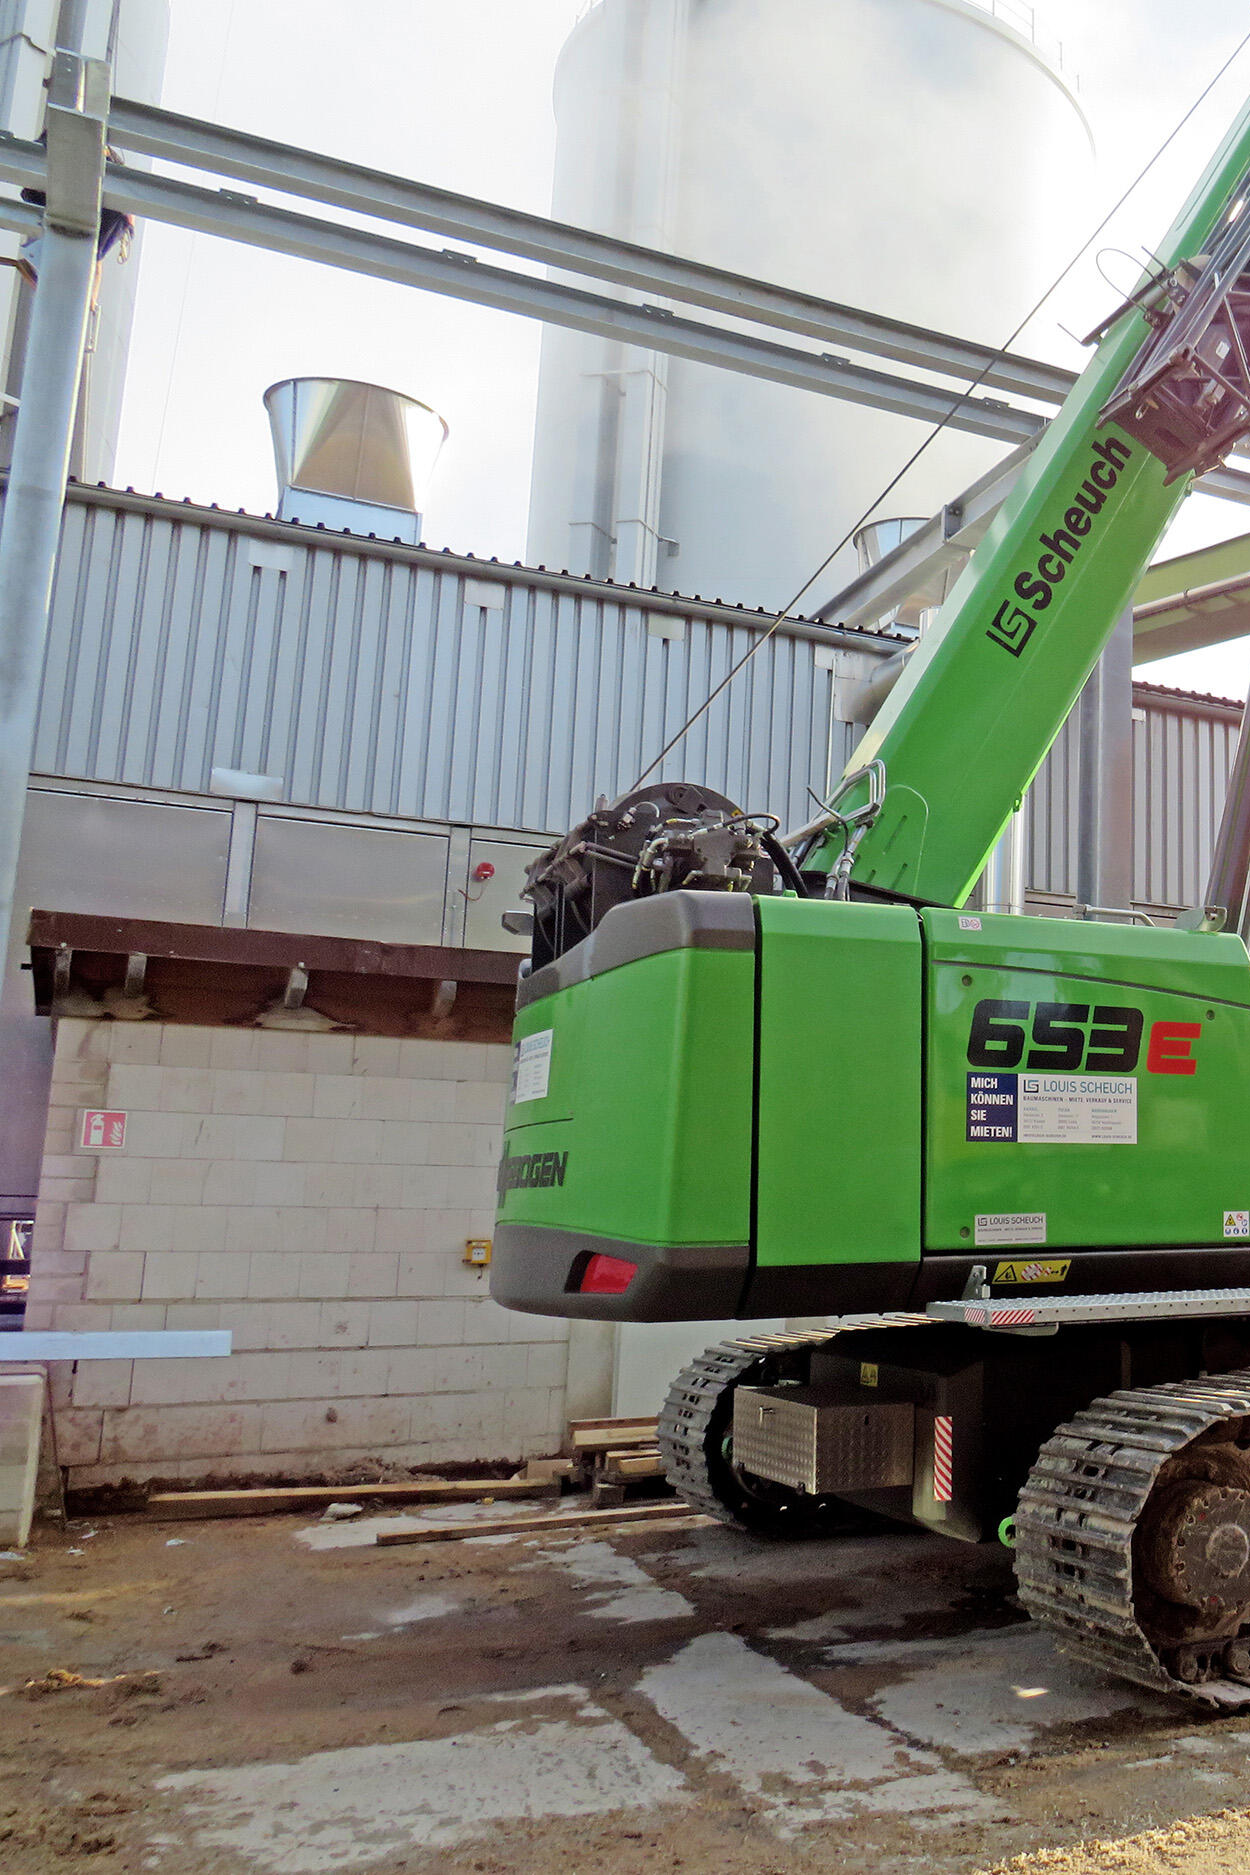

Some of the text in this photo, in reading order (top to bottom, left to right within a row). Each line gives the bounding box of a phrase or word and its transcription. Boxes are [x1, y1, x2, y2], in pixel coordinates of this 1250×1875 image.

[1013, 436, 1133, 611] Scheuch
[970, 1077, 998, 1089] MICH
[1043, 1080, 1077, 1093] LOUIS
[1080, 1081, 1133, 1095] SCHEUCH
[970, 1091, 1014, 1105] KÖNNEN
[970, 1109, 987, 1121] SIE
[970, 1126, 1013, 1138] MIETEN!
[989, 1217, 1010, 1225] LOUIS
[1011, 1215, 1044, 1225] SCHEUCH
